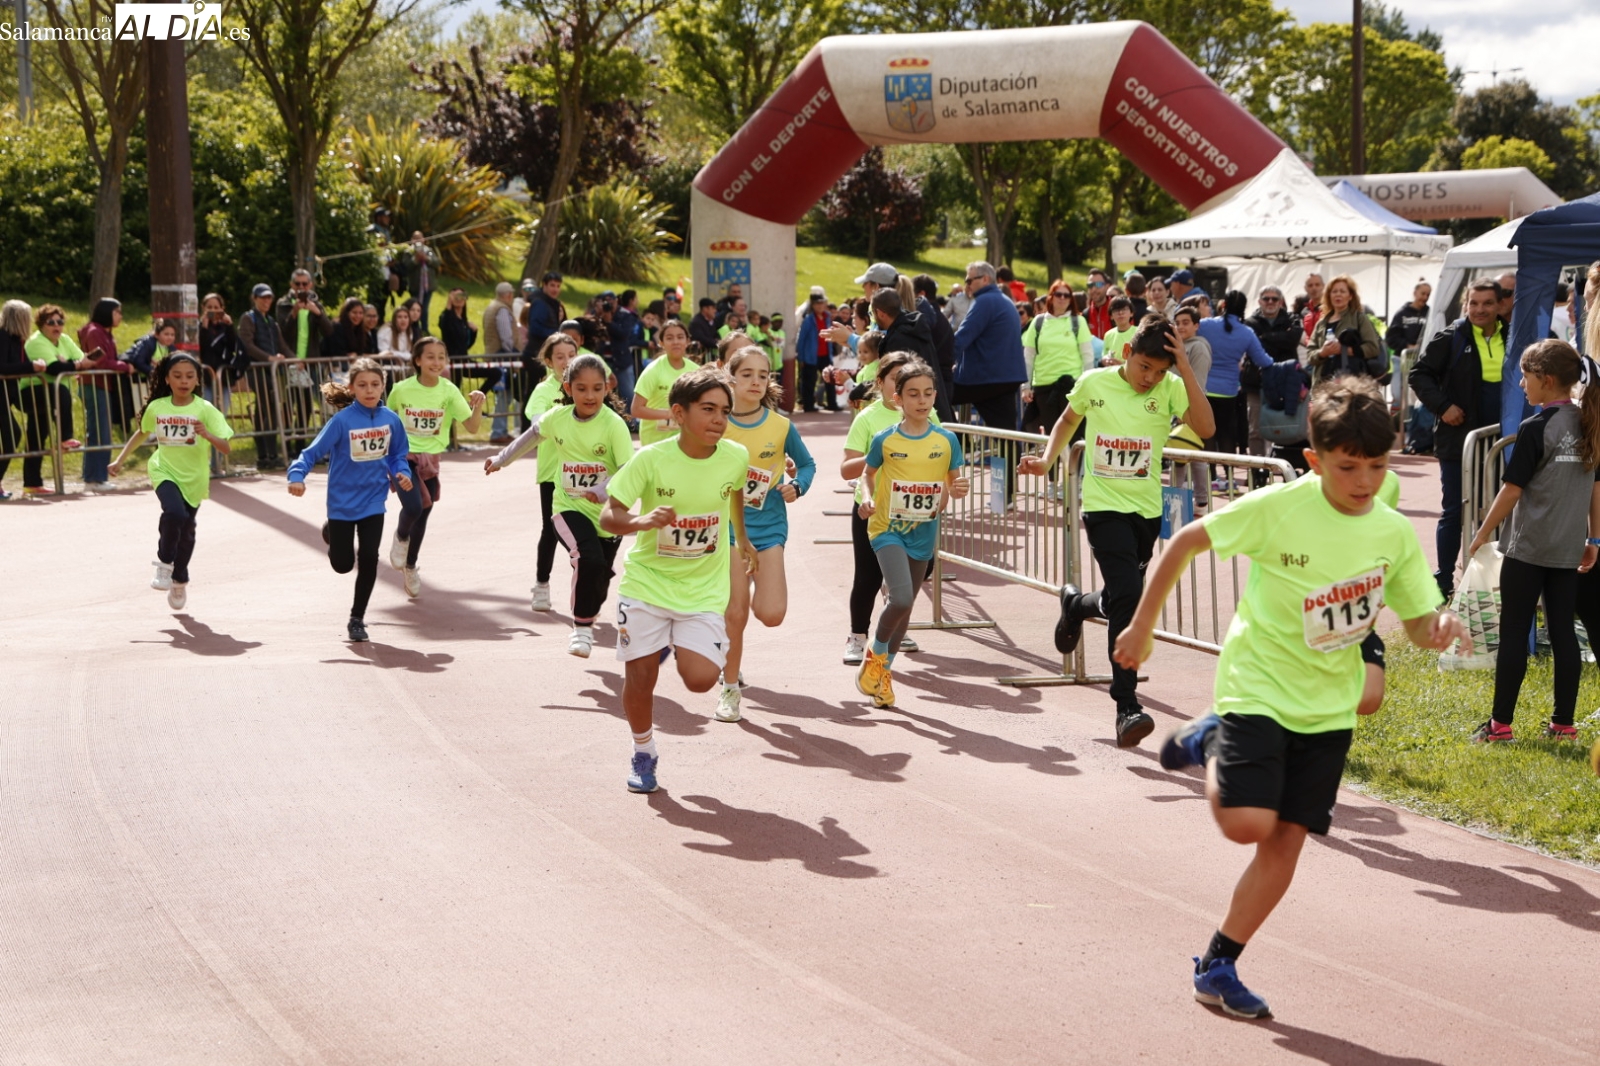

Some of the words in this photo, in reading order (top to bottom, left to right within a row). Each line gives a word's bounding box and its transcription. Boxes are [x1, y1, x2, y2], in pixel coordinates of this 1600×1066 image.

[939, 72, 1038, 97] Diputación
[942, 106, 958, 118] de
[964, 98, 1060, 117] Salamanca
[1124, 77, 1160, 110] CON
[1156, 105, 1239, 177] NUESTROS
[722, 169, 753, 202] CON
[751, 153, 772, 173] EL
[769, 86, 832, 154] DEPORTE
[1115, 100, 1216, 189] DEPORTISTAS
[1156, 239, 1211, 251] XLMOTO
[1310, 235, 1368, 243] XLMOTO
[163, 425, 188, 437] 173
[413, 417, 437, 429] 135
[360, 437, 385, 451] 162
[1096, 435, 1150, 450] bedunia
[1105, 449, 1141, 467] 117
[562, 463, 606, 474] bedunia
[570, 474, 598, 488] 142
[892, 482, 942, 495] bedunia
[903, 493, 934, 510] 183
[670, 515, 719, 529] edunia
[671, 528, 709, 546] 194
[617, 601, 630, 625] 5
[1322, 594, 1371, 632] 113
